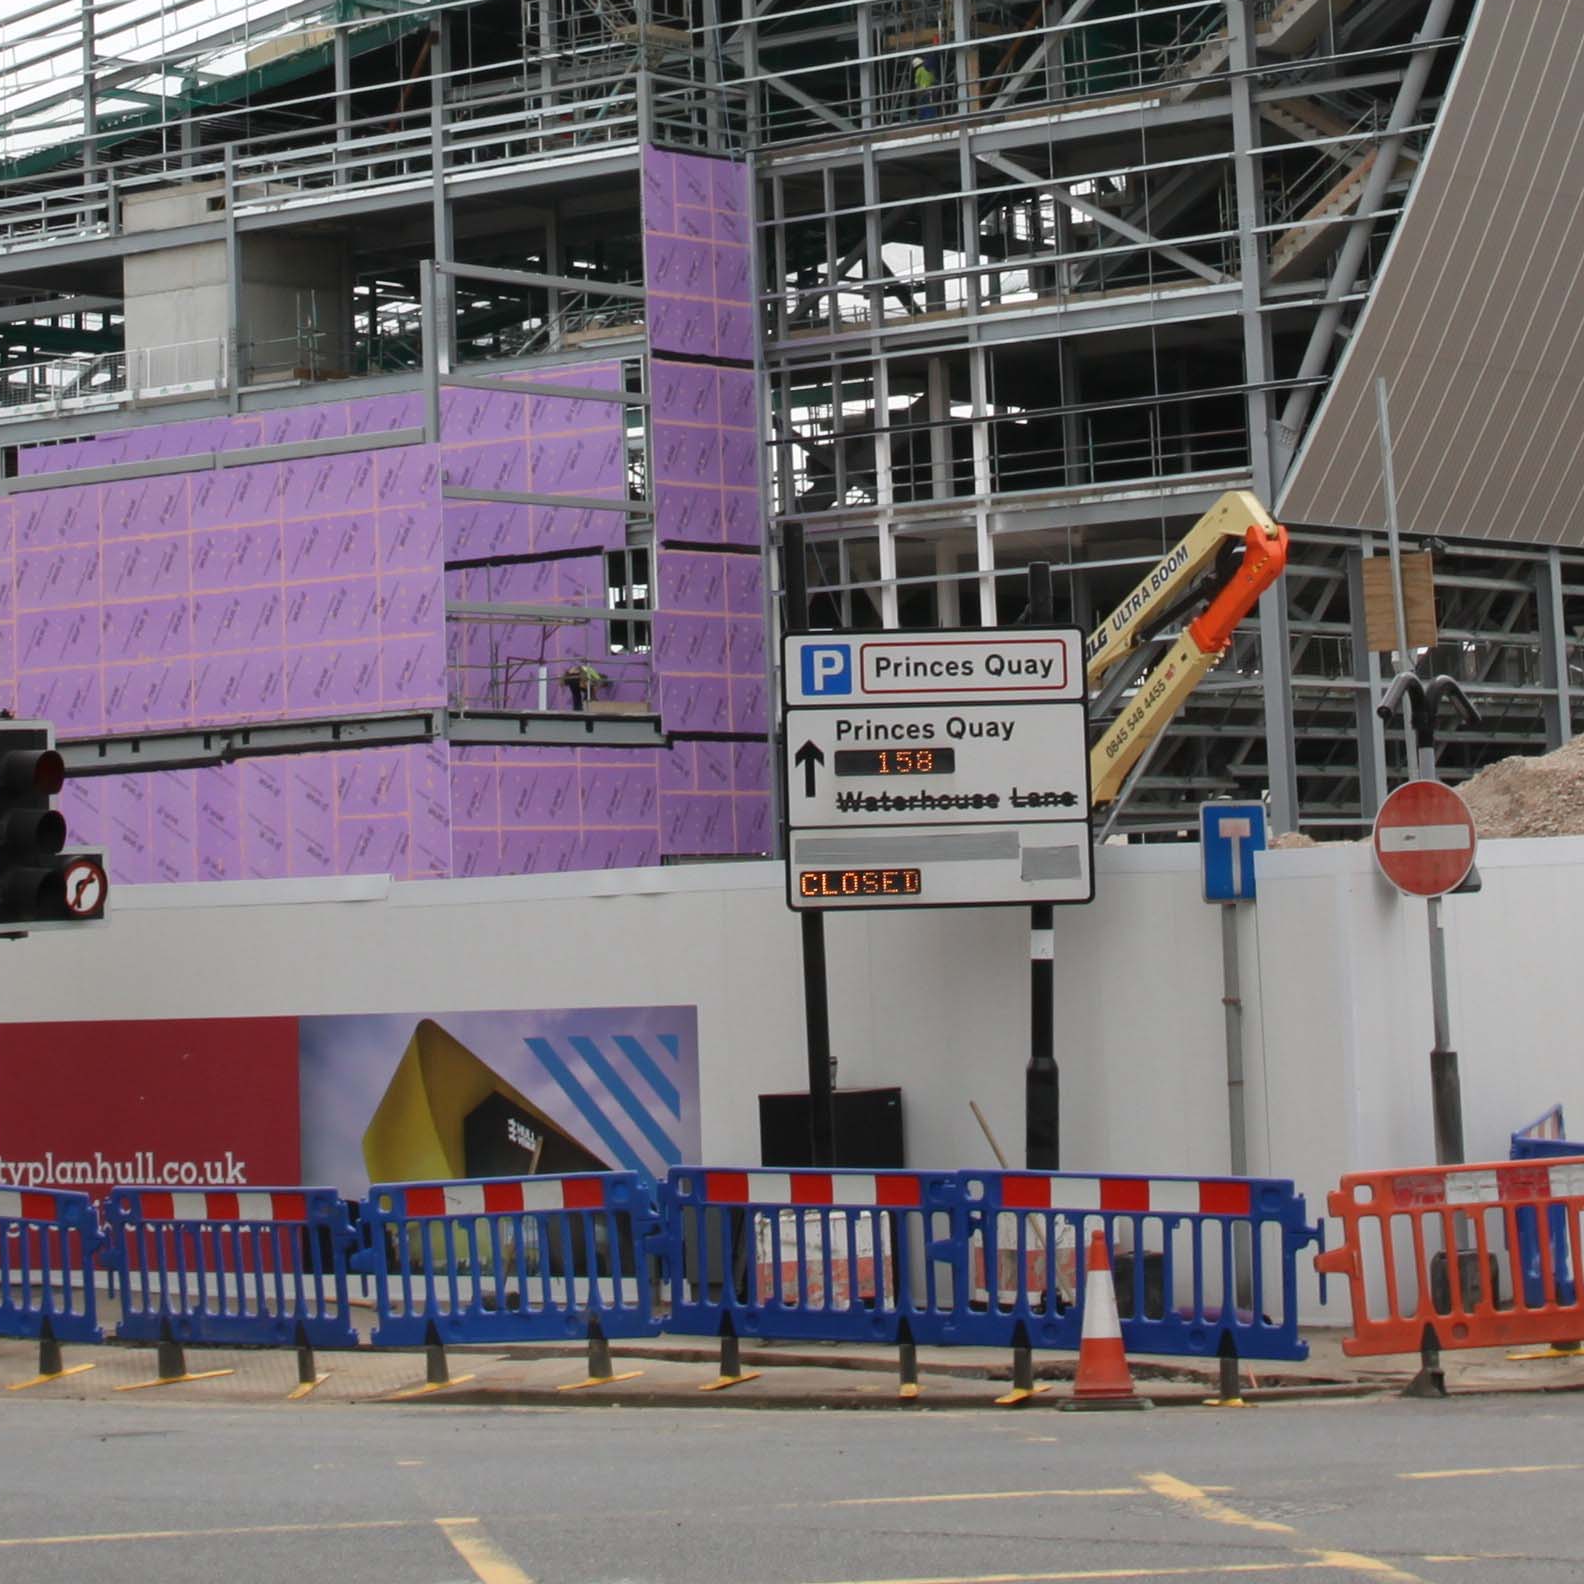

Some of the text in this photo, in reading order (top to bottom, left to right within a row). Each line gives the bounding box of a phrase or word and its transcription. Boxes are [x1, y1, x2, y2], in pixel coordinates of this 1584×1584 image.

[1112, 585, 1151, 632] ULTRA
[1150, 544, 1189, 593] BOOM
[813, 650, 844, 690] P
[875, 654, 1054, 678] Princes Quay
[836, 717, 1016, 741] Princes Quay
[878, 751, 933, 774] 158
[836, 787, 1078, 813] Waterhouse Lane
[800, 870, 920, 896] CLOSED
